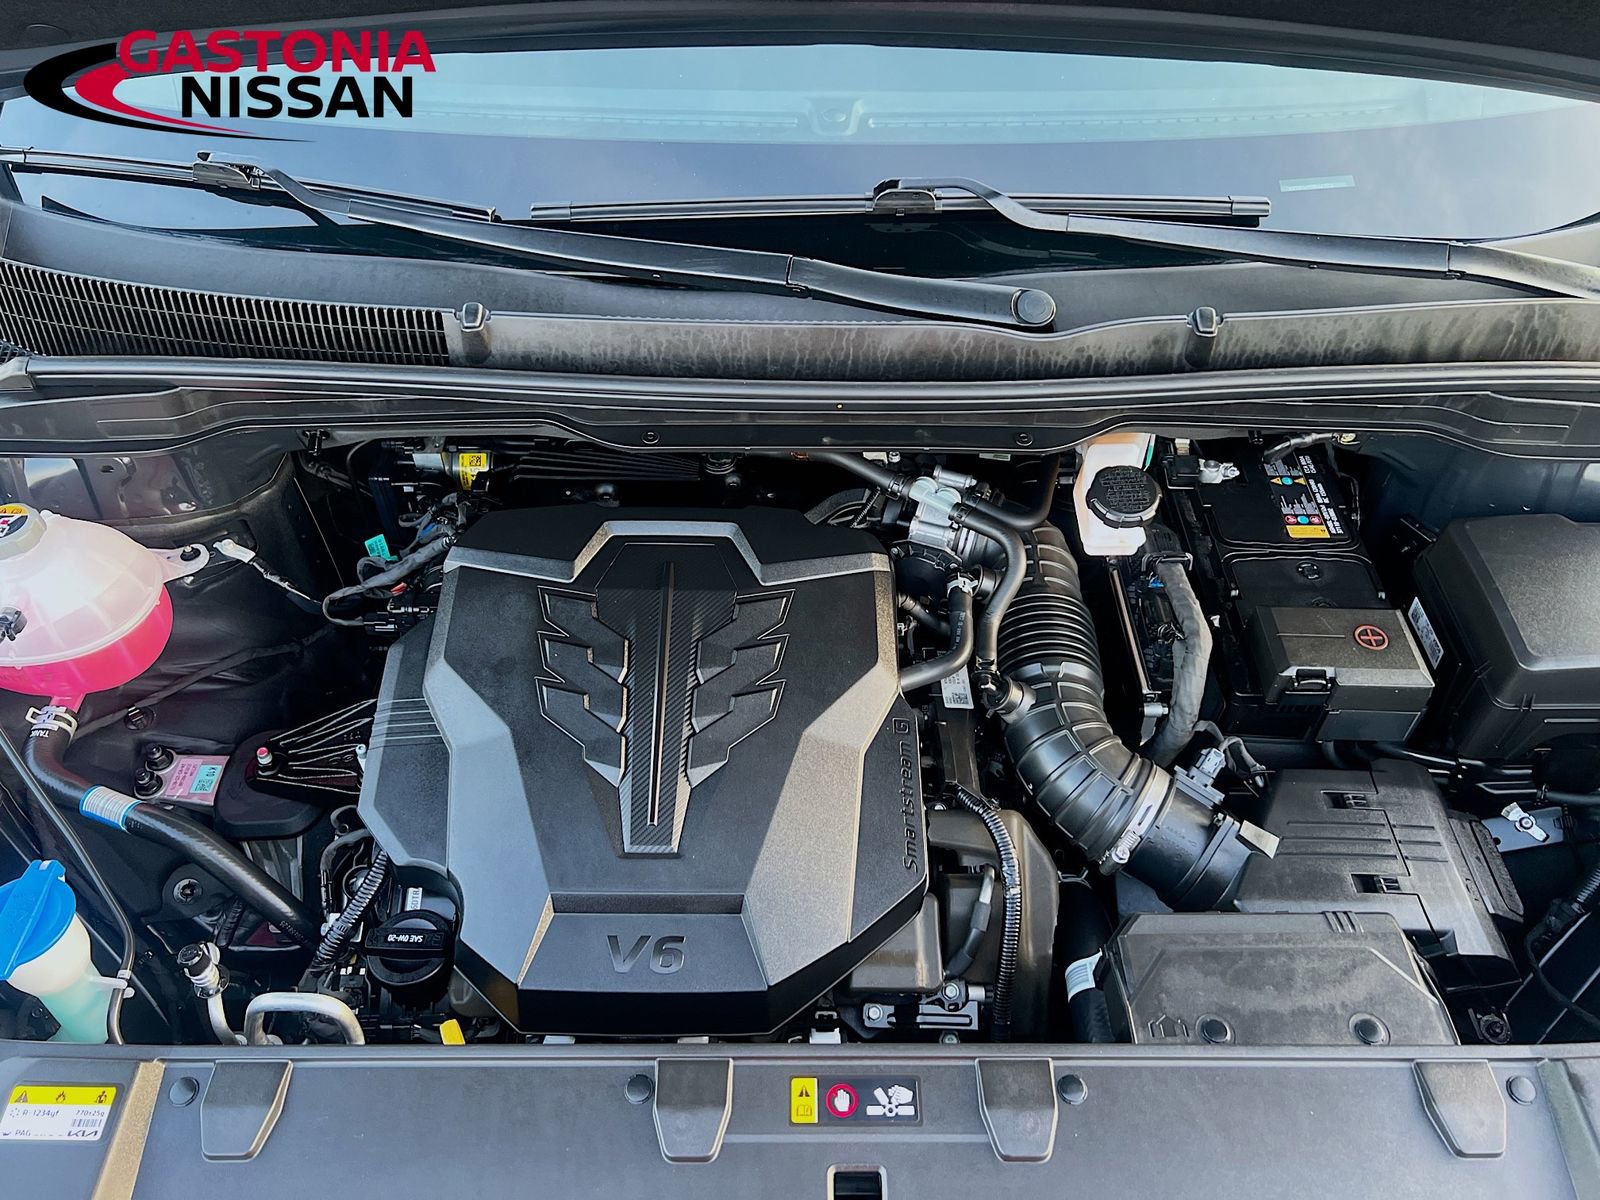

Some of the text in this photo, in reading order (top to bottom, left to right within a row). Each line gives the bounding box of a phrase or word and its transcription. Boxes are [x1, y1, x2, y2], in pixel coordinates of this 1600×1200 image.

[893, 717, 918, 873] Smartstream G
[388, 934, 409, 942] 0W-20
[606, 934, 687, 976] V6
